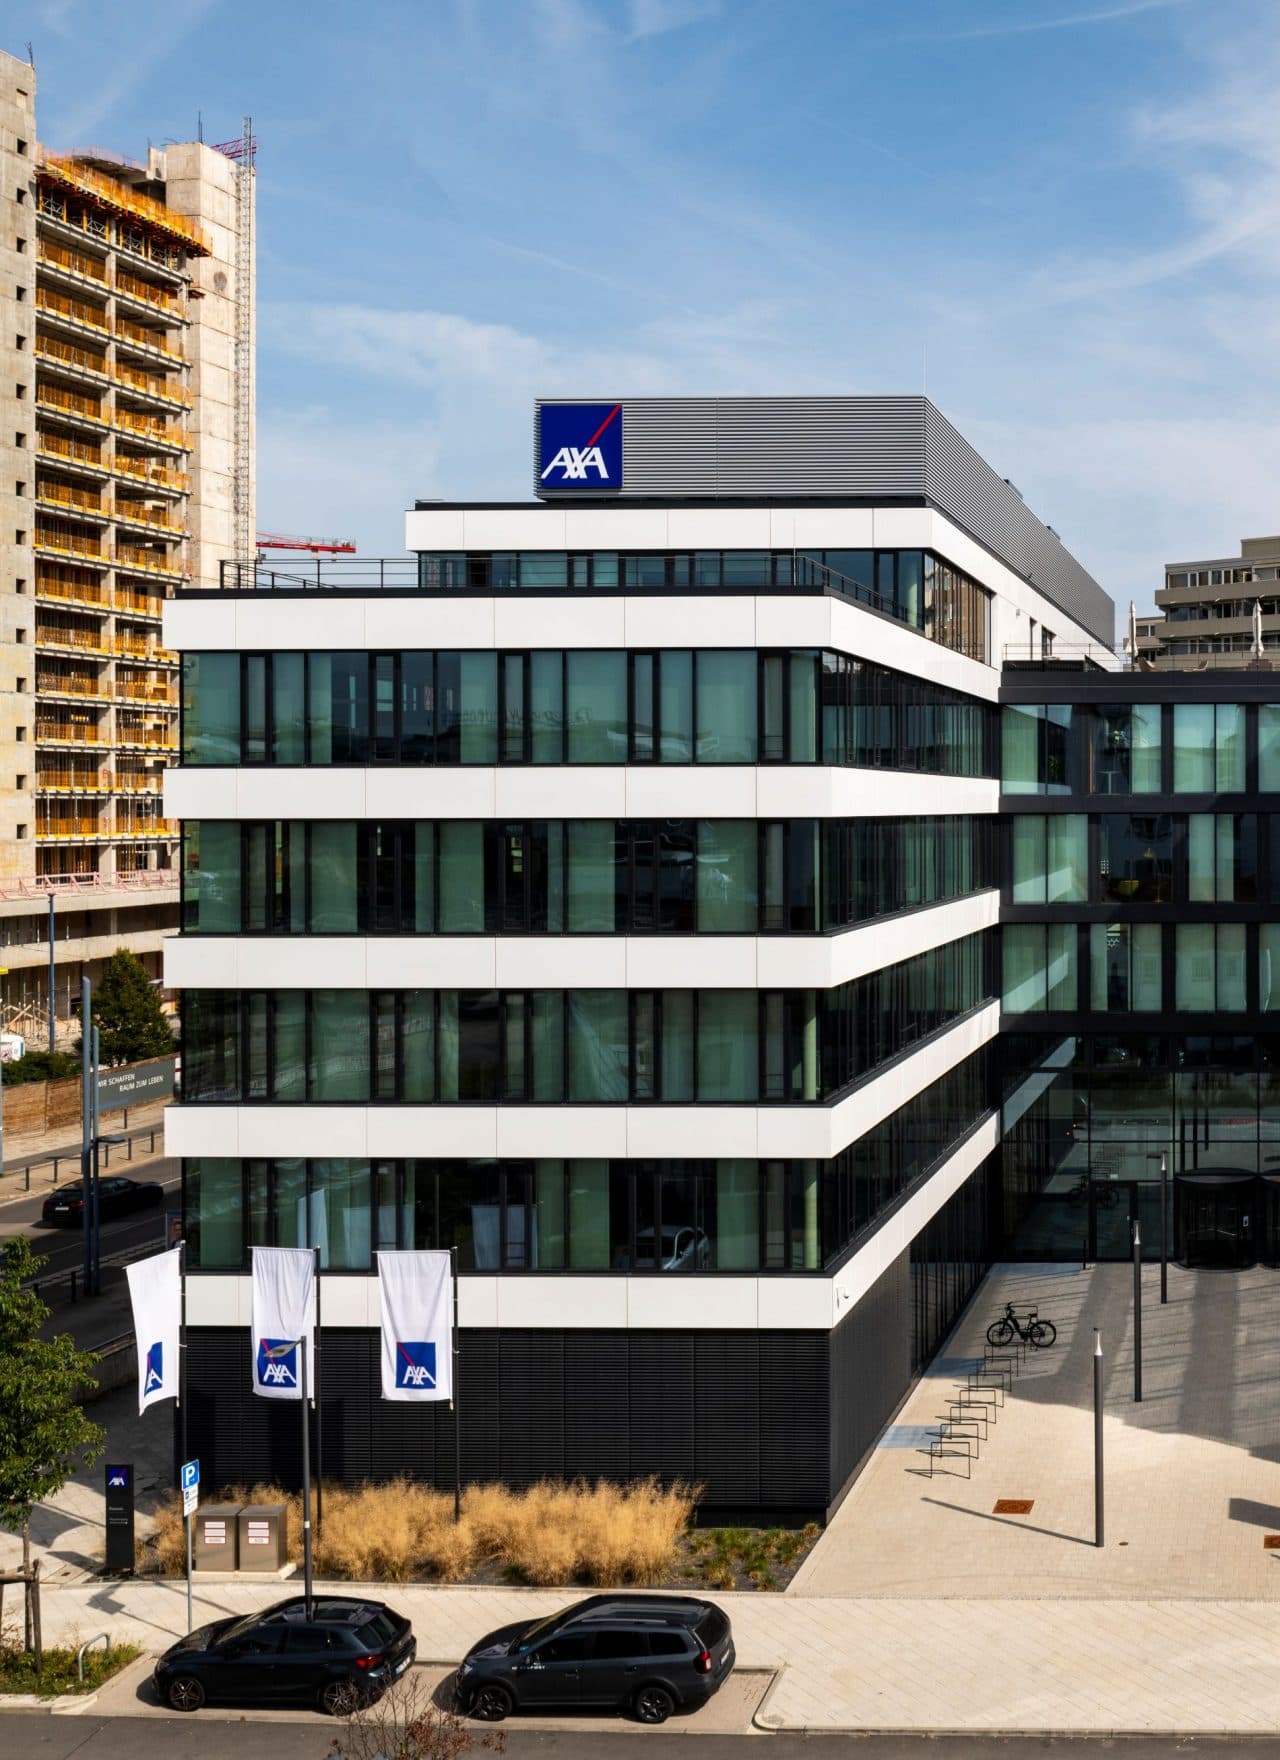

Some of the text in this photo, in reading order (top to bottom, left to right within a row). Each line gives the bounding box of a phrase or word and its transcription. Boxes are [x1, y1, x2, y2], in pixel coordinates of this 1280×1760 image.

[541, 447, 609, 479] AXA
[108, 1073, 136, 1086] SCHAFFEN
[119, 1074, 164, 1092] RAUM ZUM LEBEN
[108, 1477, 125, 1487] AXA
[185, 1465, 196, 1487] P
